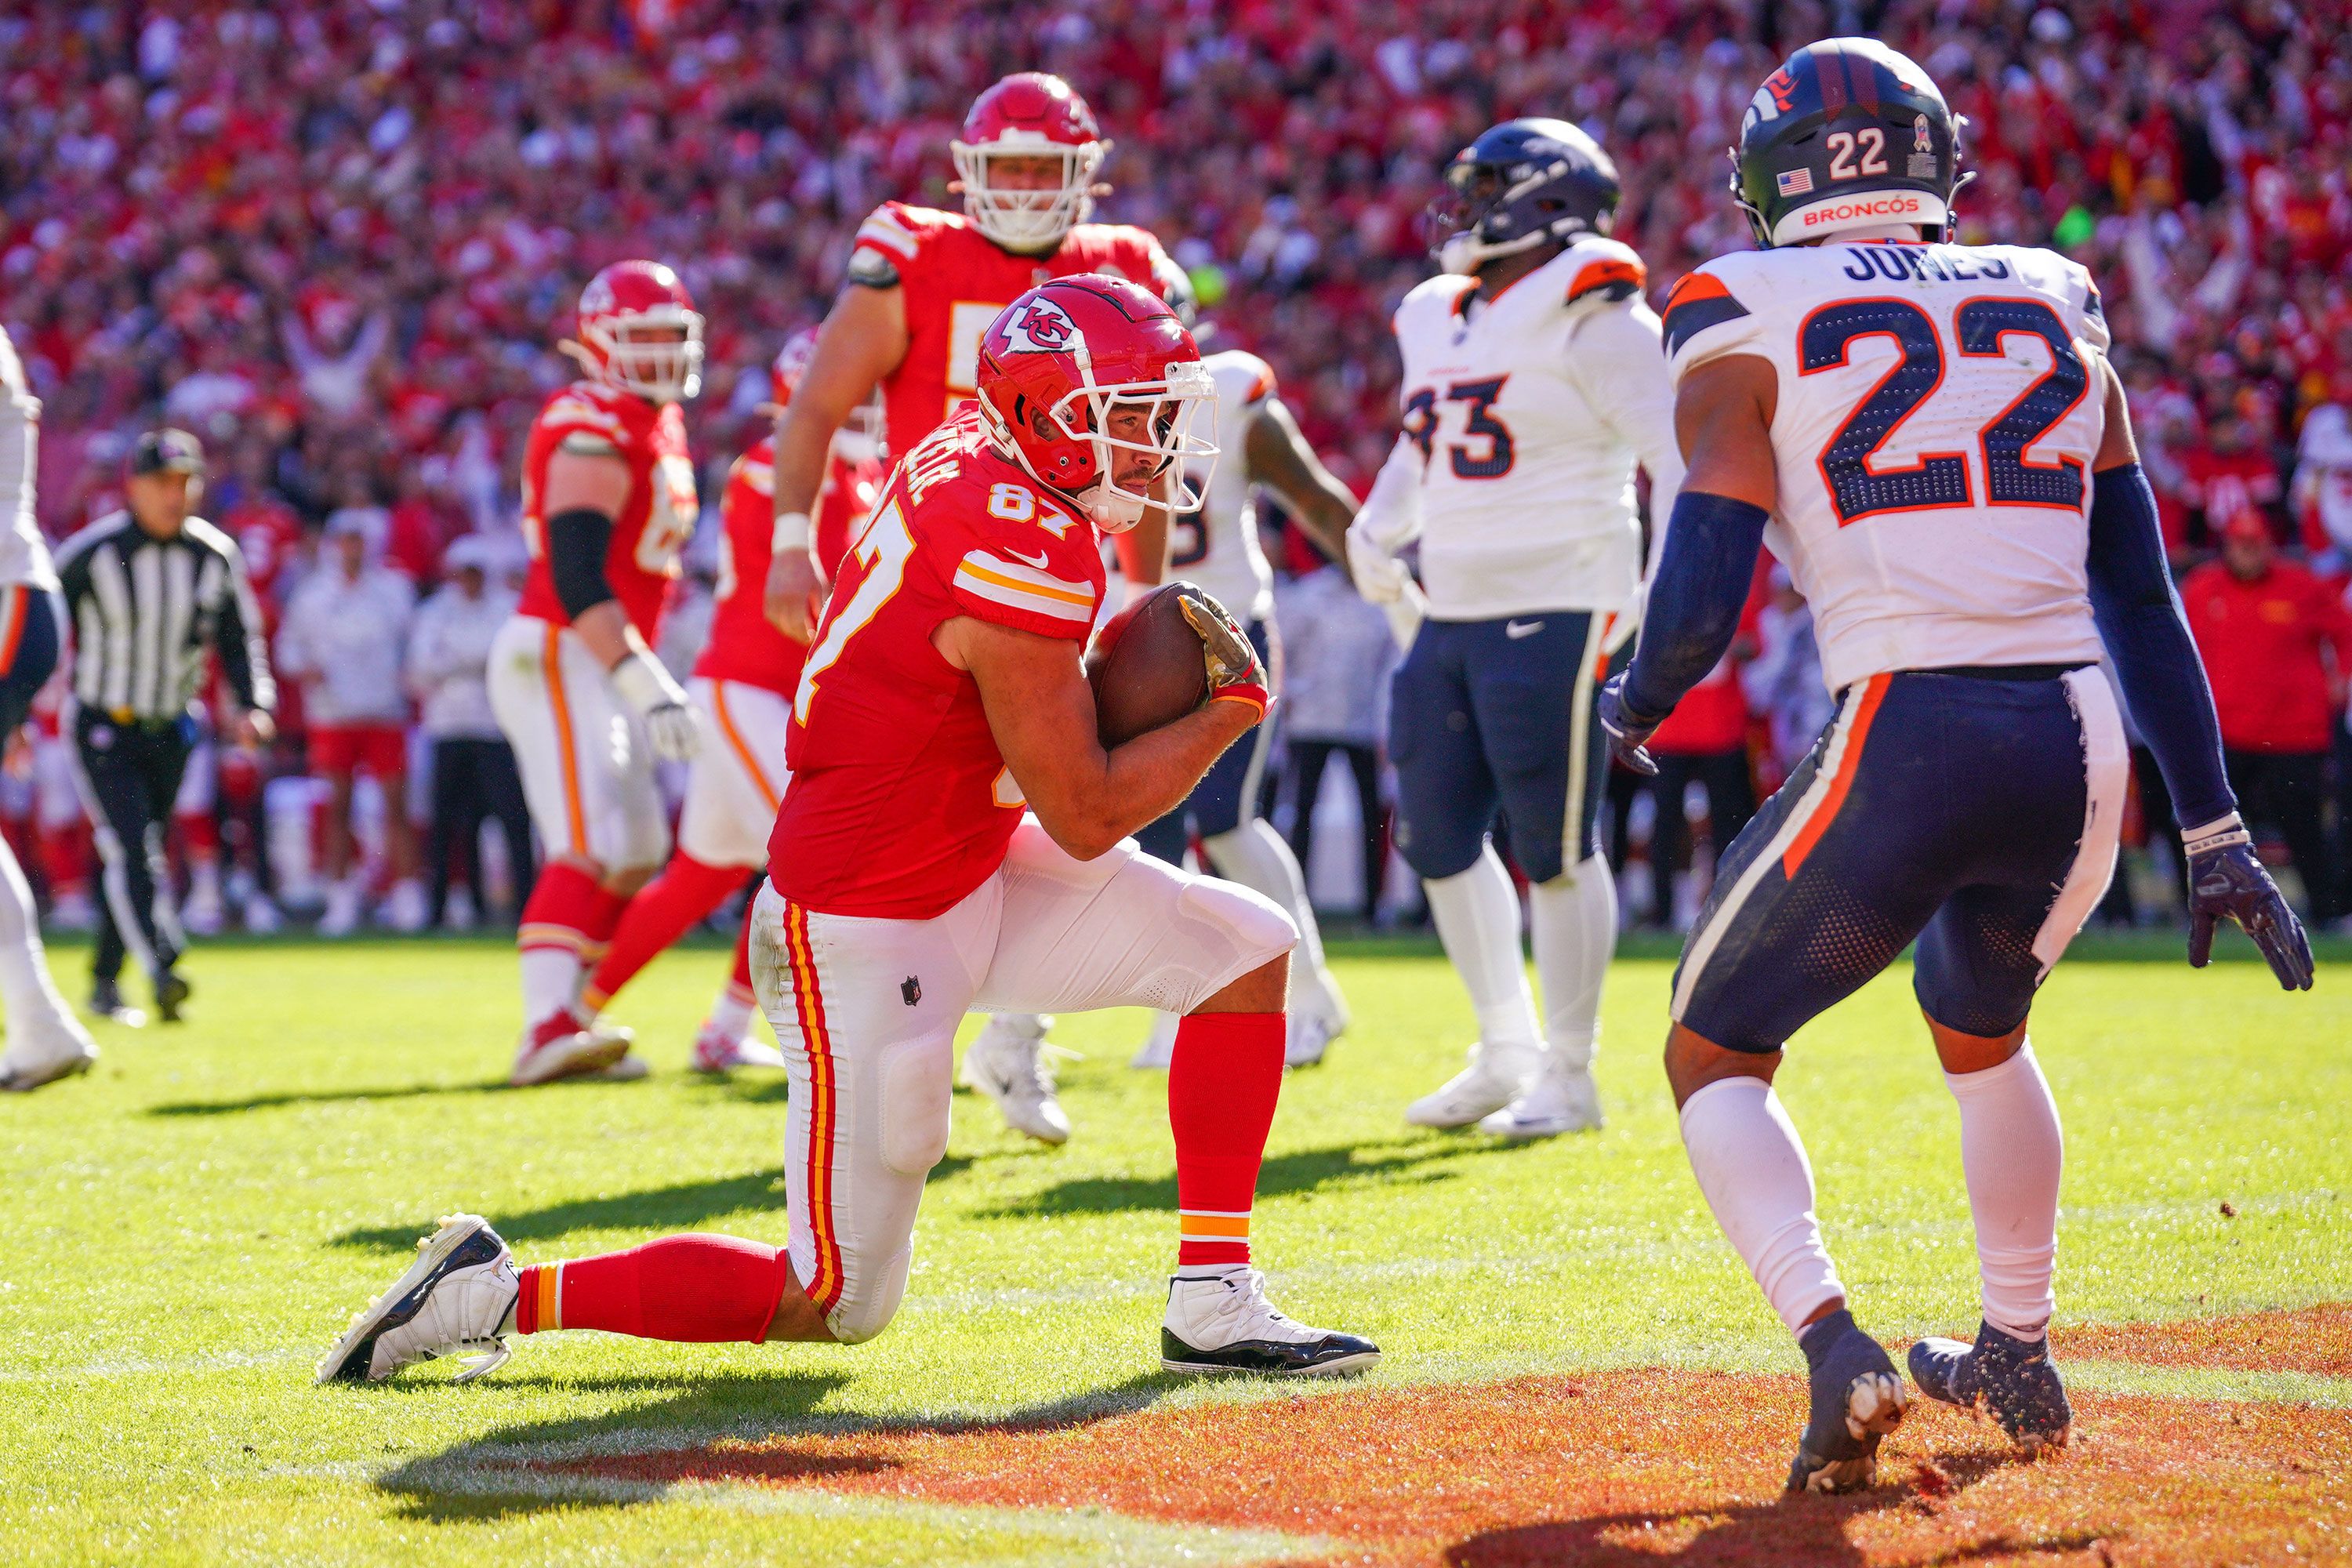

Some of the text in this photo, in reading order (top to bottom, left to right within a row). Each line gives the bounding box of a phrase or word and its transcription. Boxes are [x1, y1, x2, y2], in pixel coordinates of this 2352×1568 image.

[1827, 128, 1889, 181] 22
[1803, 198, 1919, 226] BRONCOS
[1796, 296, 2089, 528] 22
[987, 482, 1080, 541] 87
